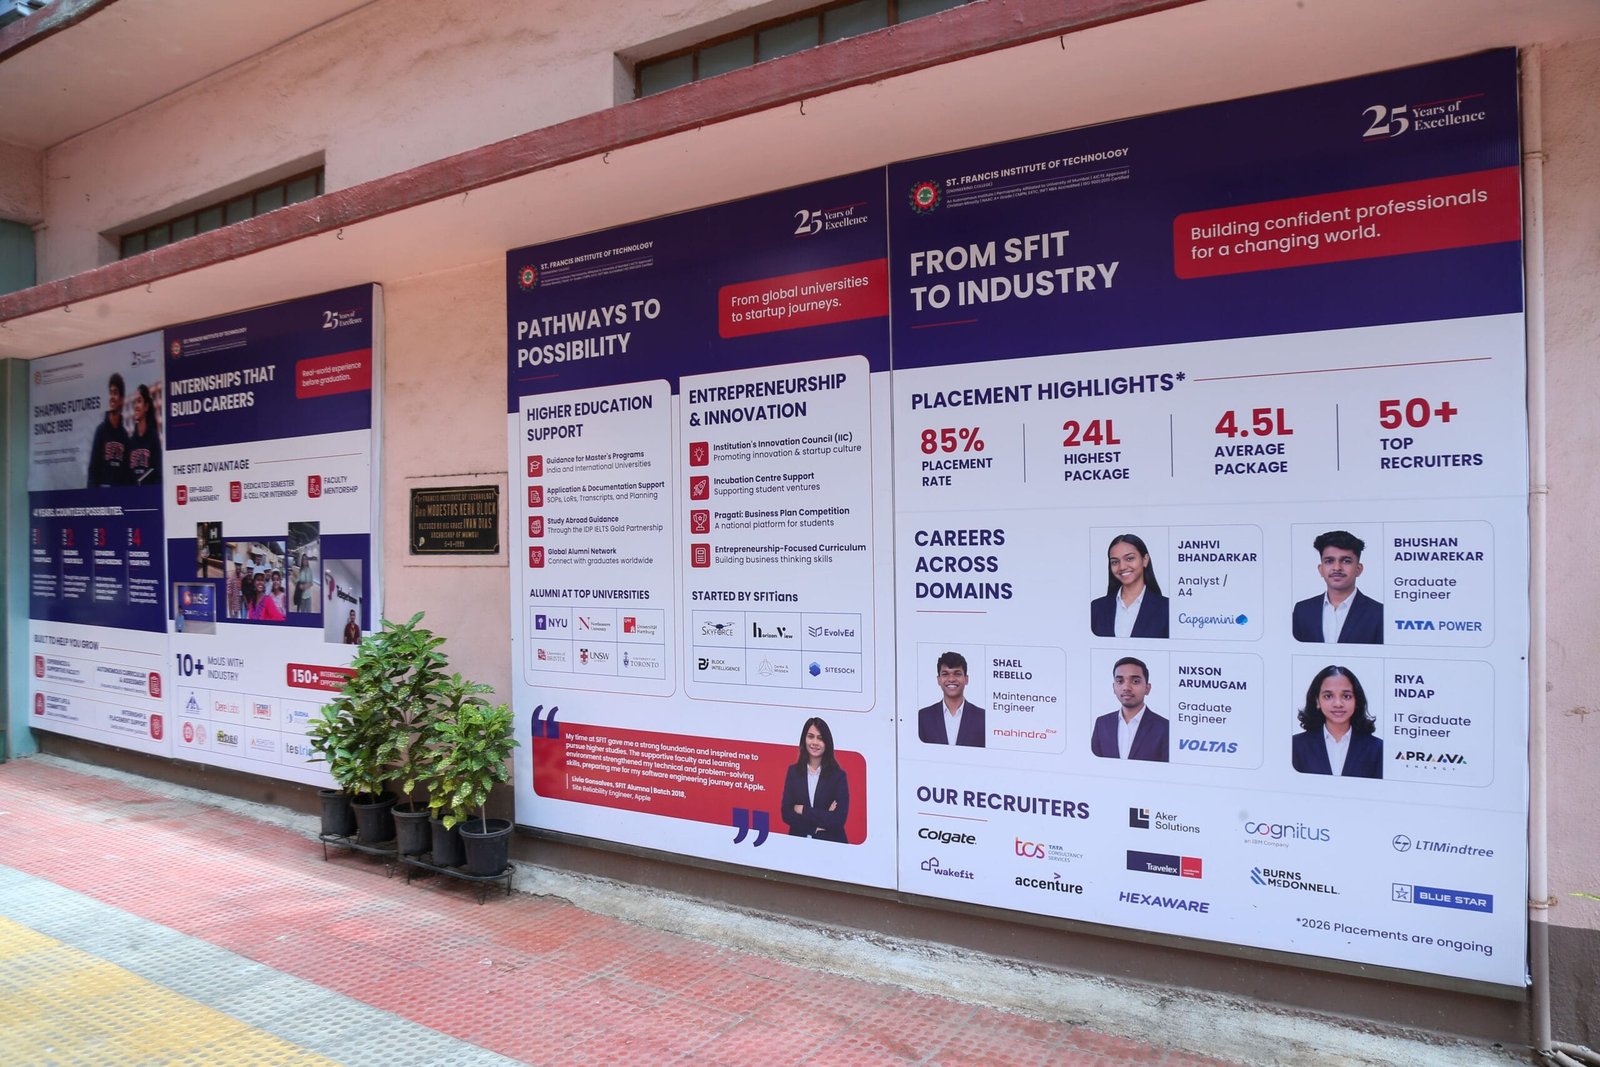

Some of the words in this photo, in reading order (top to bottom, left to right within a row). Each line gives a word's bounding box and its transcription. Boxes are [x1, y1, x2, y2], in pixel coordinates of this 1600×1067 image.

[1413, 107, 1445, 117] Years
[1448, 101, 1461, 115] of
[1363, 105, 1409, 137] 25
[1415, 112, 1485, 130] Excellence
[946, 178, 959, 186] ST.
[961, 171, 999, 184] FRANCIS
[1001, 162, 1046, 177] INSTITUTE
[1048, 160, 1060, 168] OF
[1063, 148, 1128, 166] TECHNOLOGY
[825, 212, 844, 220] Years
[844, 207, 853, 218] of
[1192, 221, 1259, 240] Building
[1265, 208, 1351, 230] confident
[1357, 189, 1487, 223] professionals
[795, 210, 822, 234] 25
[826, 216, 867, 230] Excellence
[1192, 246, 1214, 259] for
[1219, 245, 1229, 256] a
[1235, 234, 1319, 253] changing
[1324, 224, 1380, 242] world.
[550, 258, 573, 268] FRANCIS
[575, 252, 602, 263] INSTITUTE
[613, 242, 653, 255] TECHNOLOGY
[911, 242, 995, 276] FROM
[1005, 231, 1069, 263] SFIT
[732, 295, 759, 306] From
[762, 286, 797, 305] global
[801, 274, 870, 295] universities
[911, 285, 950, 311] TO
[959, 262, 1119, 305] INDUSTRY
[732, 313, 742, 322] to
[746, 307, 785, 320] startup
[788, 298, 841, 317] journeys.
[518, 304, 626, 340] PATHWAYS
[632, 299, 660, 321] TO
[518, 333, 630, 367] POSSIBILITY
[171, 371, 241, 395] INTERNSHIPS
[243, 365, 275, 384] THAT
[690, 373, 846, 404] ENTREPRENEURSHIP
[172, 400, 201, 416] BUILD
[203, 392, 254, 412] CAREERS
[912, 385, 1032, 409] PLACEMENT
[35, 402, 68, 417] SHAPING
[68, 395, 102, 414] FUTURES
[528, 405, 571, 421] HIGHER
[575, 395, 652, 416] EDUCATION
[690, 413, 700, 426] &
[705, 402, 806, 425] INNOVATION
[1380, 398, 1457, 429] 50+
[1215, 408, 1293, 437] 4.5L
[528, 424, 583, 441] SUPPORT
[1063, 420, 1120, 446] 24L
[714, 441, 756, 451] Institution's
[758, 438, 800, 447] Innovation
[802, 435, 832, 444] Council
[835, 432, 852, 443] (IIC)
[921, 427, 984, 454] 85%
[1380, 438, 1413, 450] TOP
[714, 452, 751, 461] Promoting
[753, 449, 792, 458] innovation
[802, 447, 831, 455] startup
[833, 445, 861, 453] culture
[1215, 443, 1284, 457] AVERAGE
[922, 458, 992, 471] PLACEMENT
[1065, 452, 1121, 464] HIGHEST
[1381, 454, 1483, 469] RECRUITERS
[173, 465, 185, 474] THE
[187, 464, 201, 474] SFIT
[203, 459, 249, 472] ADVANTAGE
[1215, 461, 1287, 475] PACKAGE
[923, 476, 951, 486] RATE
[1065, 469, 1129, 481] PACKAGE
[324, 486, 358, 494] MENTORSHIP
[915, 529, 1004, 546] CAREERS
[1395, 538, 1457, 547] BHUSHAN
[1178, 541, 1219, 549] JANHVI
[1178, 553, 1256, 562] BHANDARKAR
[1395, 552, 1483, 561] ADIWAREKAR
[915, 556, 998, 572] ACROSS
[1178, 577, 1219, 589] Analyst
[1223, 574, 1227, 587] /
[1394, 577, 1456, 586] Graduate
[530, 589, 560, 597] ALUMNI
[562, 589, 572, 597] AT
[574, 590, 590, 598] TOP
[593, 590, 649, 599] UNIVERSITIES
[692, 591, 735, 601] STARTED
[738, 592, 751, 601] BY
[754, 591, 798, 602] SFITians
[916, 583, 1012, 599] DOMAINS
[1178, 588, 1192, 596] A4
[1395, 589, 1451, 602] Engineer
[549, 618, 567, 628] NYU
[1179, 613, 1236, 628] Capgemini
[1395, 620, 1434, 630] TATA
[1439, 621, 1481, 631] POWER
[824, 629, 854, 637] EvolvEd
[208, 656, 225, 666] MoUS
[227, 658, 243, 667] WITH
[590, 652, 608, 660] UNSW
[993, 659, 1022, 667] SHAEL
[177, 654, 204, 676] 10+
[1179, 666, 1221, 676] NIXSON
[208, 670, 238, 680] INDUSTRY
[293, 669, 319, 683] 150+
[993, 671, 1032, 680] REBELLO
[1395, 675, 1424, 684] RIYA
[1179, 679, 1246, 690] ARUMUGAM
[993, 692, 1057, 704] Maintenance
[1395, 689, 1434, 698] INDAP
[993, 701, 1034, 713] Engineer
[1178, 702, 1231, 714] Graduate
[1179, 713, 1226, 725] Engineer
[1395, 713, 1404, 722] IT
[1408, 714, 1471, 728] Graduate
[994, 729, 1048, 739] mahindra
[1394, 726, 1450, 738] Engineer
[1179, 739, 1238, 753] VOLTAS
[1396, 751, 1466, 764] APRAAVA
[917, 786, 957, 805] OUR
[964, 791, 1089, 819] RECRUITERS
[1155, 812, 1177, 823] Aker
[1155, 820, 1200, 833] Solutions
[1416, 841, 1494, 857] LTIMindtree
[933, 866, 974, 879] wakefit
[1145, 863, 1177, 875] Travelex
[1262, 869, 1301, 882] BURNS
[1015, 874, 1083, 894] accenture
[1119, 892, 1209, 913] HEXAWARE
[1420, 892, 1451, 904] BLUE
[1455, 896, 1486, 908] STAR
[1334, 923, 1408, 941] Placements
[1412, 935, 1433, 944] are
[1437, 939, 1492, 956] ongoing
